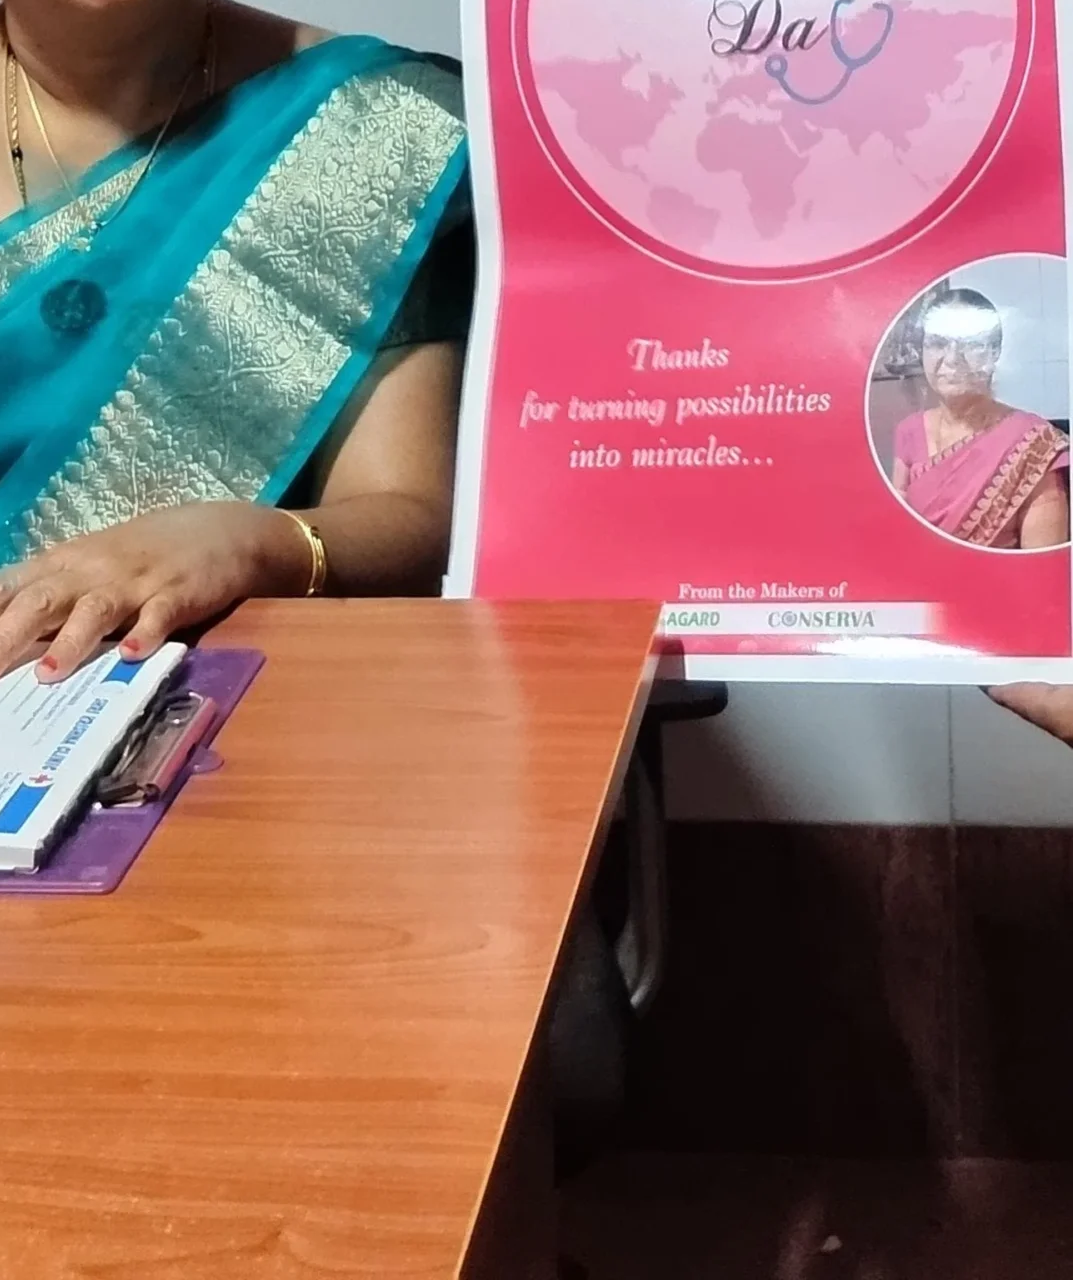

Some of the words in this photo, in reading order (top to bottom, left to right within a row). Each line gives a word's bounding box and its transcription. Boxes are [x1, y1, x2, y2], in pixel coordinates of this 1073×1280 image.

[627, 337, 730, 371] Thanks
[519, 389, 560, 428] for
[568, 389, 667, 427] turning
[676, 383, 832, 425] possibilities
[569, 439, 622, 469] into
[631, 434, 774, 467] miracles...
[678, 583, 723, 600] From
[728, 583, 756, 599] the
[760, 582, 824, 599] Makers
[829, 581, 848, 598] of
[767, 610, 875, 628] CONSERVA
